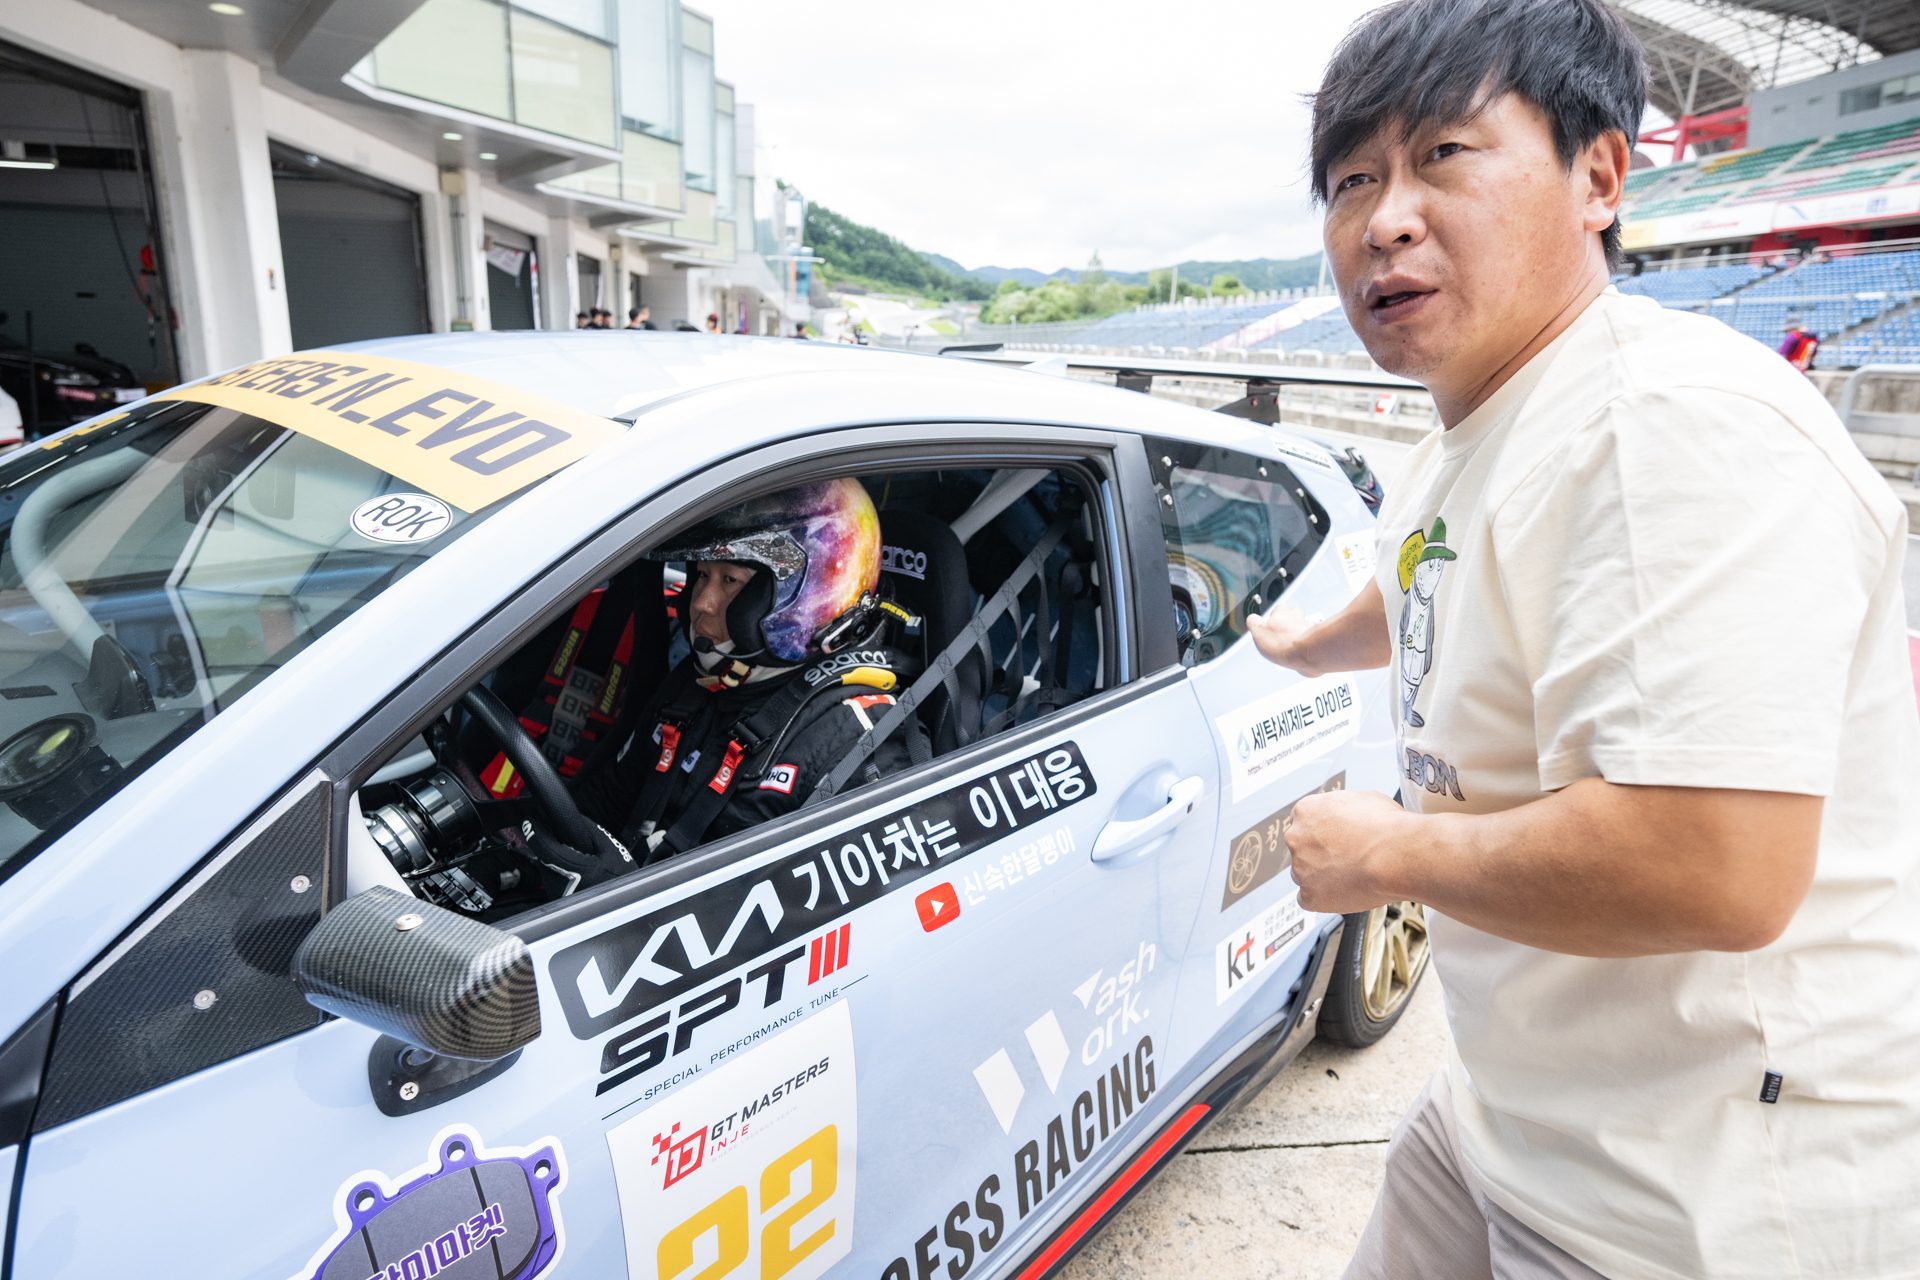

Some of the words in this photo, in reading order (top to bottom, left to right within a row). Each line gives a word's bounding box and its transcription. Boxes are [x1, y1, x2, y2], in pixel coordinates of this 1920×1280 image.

[361, 497, 446, 538] ROK
[1251, 704, 1315, 750] 세탁세제는
[1315, 683, 1352, 718] 아이엠
[790, 819, 960, 912] 기아차는
[963, 826, 1077, 908] 신속한달팽이
[1227, 931, 1256, 989] kt
[643, 1063, 703, 1101] SPECIAL
[710, 1006, 803, 1065] PERFORMANCE
[809, 987, 840, 1010] TUNE
[711, 1112, 738, 1141] GT
[741, 1056, 831, 1123] MASTERS
[1014, 1034, 1156, 1220] RACING
[710, 1124, 750, 1156] INJE
